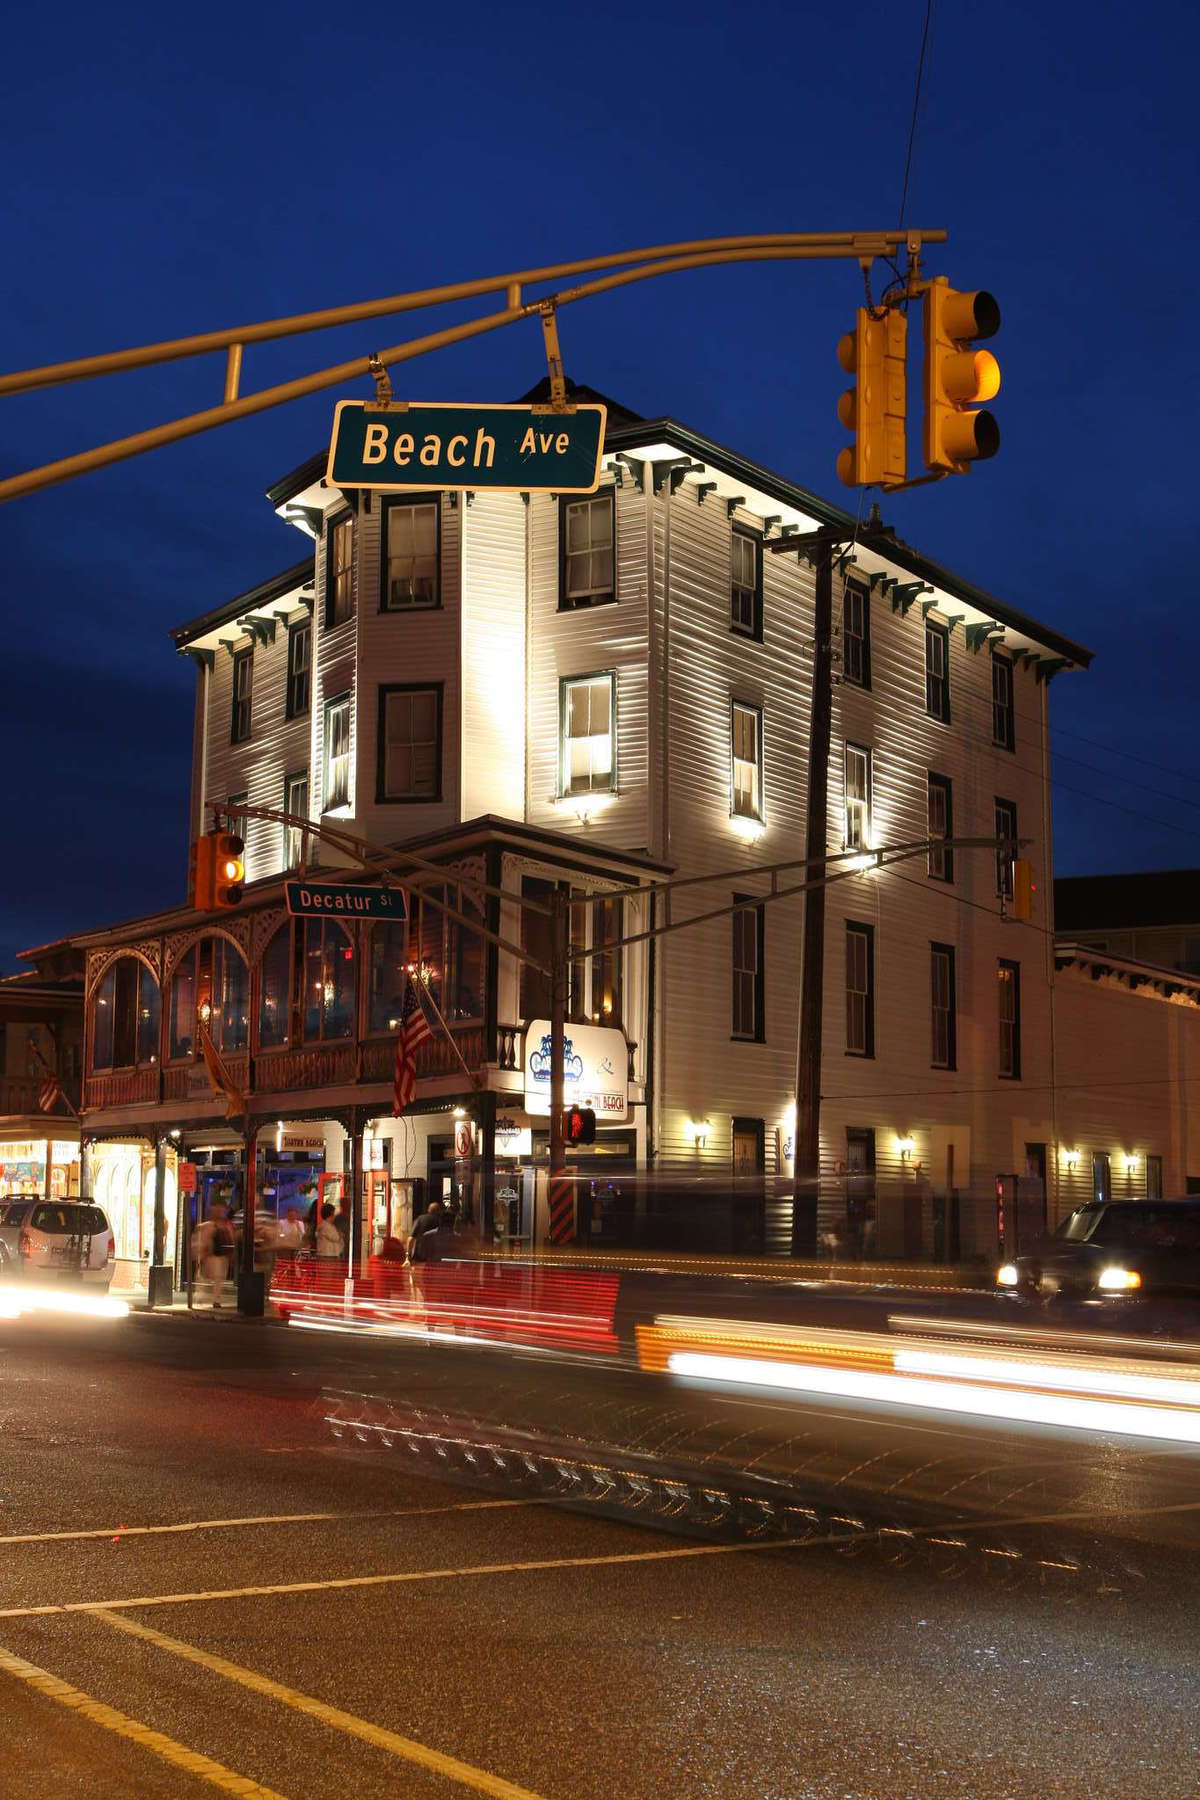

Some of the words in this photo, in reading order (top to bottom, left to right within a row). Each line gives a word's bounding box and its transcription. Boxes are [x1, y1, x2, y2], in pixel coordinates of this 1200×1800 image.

[362, 423, 496, 467] Beach
[519, 428, 570, 454] Ave
[300, 890, 371, 910] Decatur
